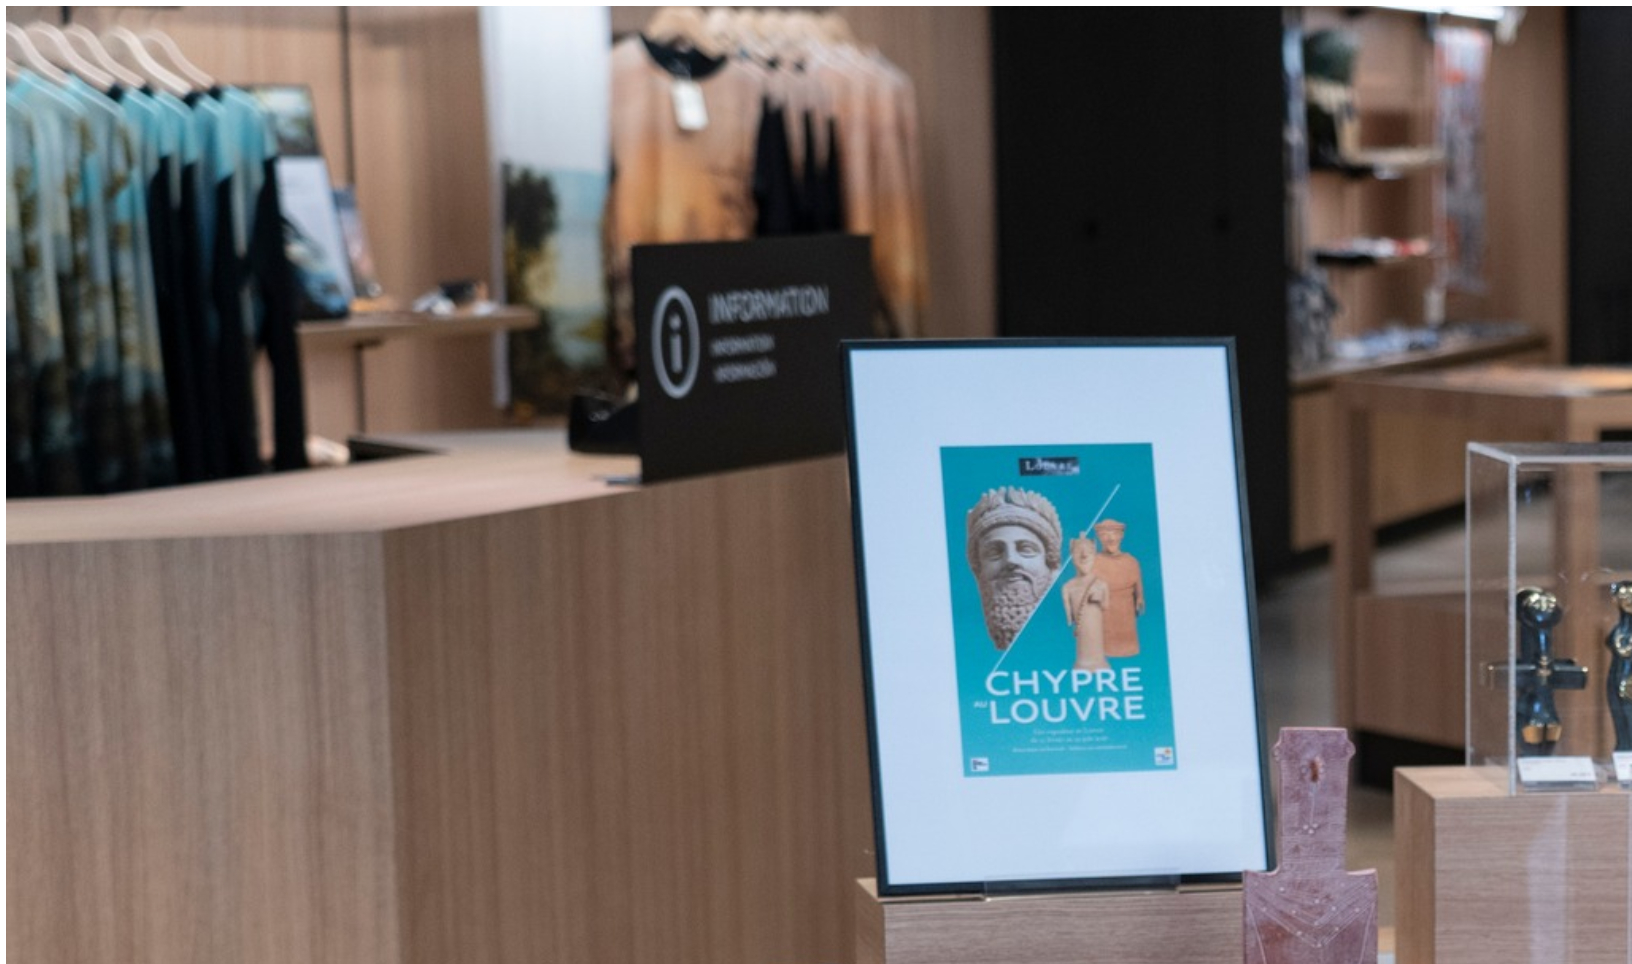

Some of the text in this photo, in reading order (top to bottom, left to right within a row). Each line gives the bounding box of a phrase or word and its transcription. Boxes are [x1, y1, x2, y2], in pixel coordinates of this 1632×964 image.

[708, 285, 829, 324] INFORMATION
[985, 667, 1144, 696] CHYPRE
[989, 696, 1146, 724] LOUVRE
